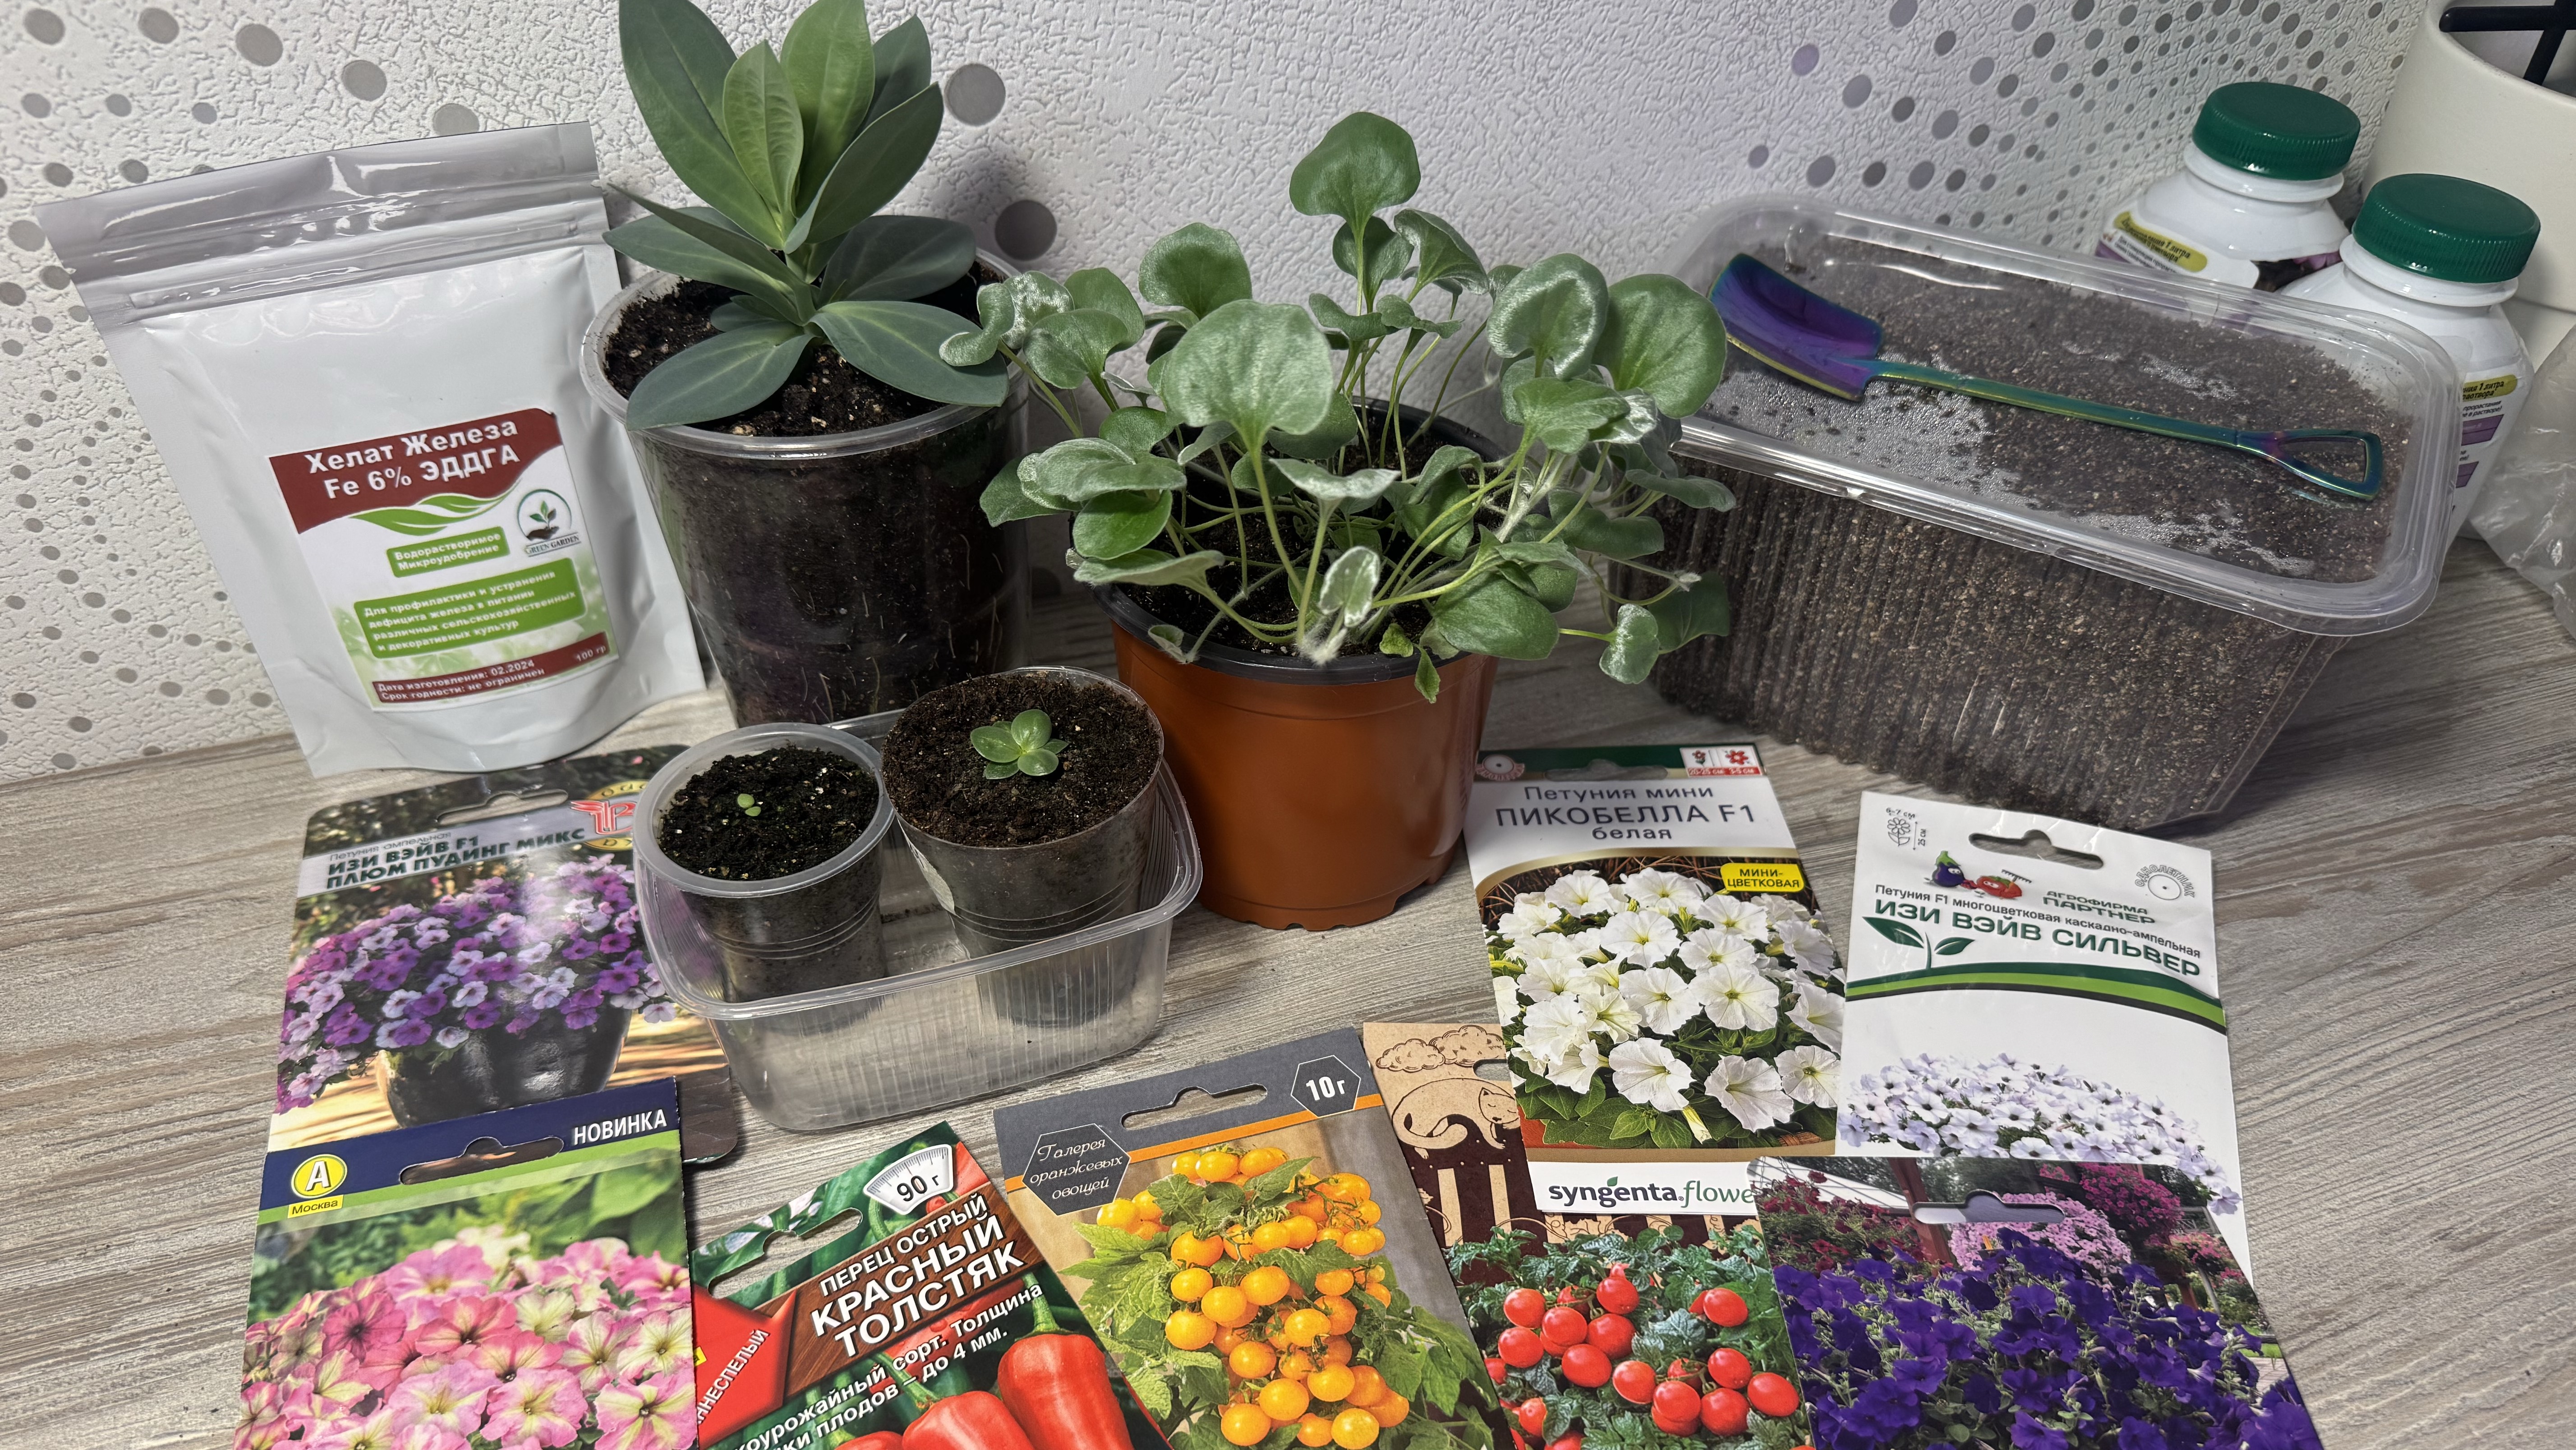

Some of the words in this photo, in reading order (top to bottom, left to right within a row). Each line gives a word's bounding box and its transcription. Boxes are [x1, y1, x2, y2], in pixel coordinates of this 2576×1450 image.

[2484, 381, 2504, 391] литра
[304, 444, 393, 474] Хелат
[401, 420, 518, 457] Железа
[324, 478, 360, 499] Fe
[368, 466, 412, 492] 6%
[421, 444, 520, 481] ЭДДГА
[395, 534, 501, 561] Водорастворимое
[397, 545, 499, 571] Микроудобрение
[525, 543, 549, 554] GREEN
[551, 535, 579, 548] GARDEN
[363, 607, 387, 618] Для
[390, 590, 477, 614] профилактики
[489, 571, 556, 595] устранения
[368, 613, 427, 629] дефицита
[430, 603, 474, 619] железа
[487, 589, 535, 607] питании
[373, 624, 439, 641] различных
[442, 590, 576, 630] сельскохозяйственных
[389, 631, 471, 652] декоративных
[474, 620, 519, 636] культур
[576, 650, 593, 662] 100
[595, 644, 607, 656] гр
[378, 682, 404, 692] Дата
[408, 672, 488, 690] изготовления:
[490, 659, 535, 676] 02.2024
[382, 690, 409, 701] Срок
[411, 686, 466, 698] годности:
[468, 682, 483, 691] не
[485, 668, 545, 688] ограничен
[1524, 786, 1636, 802] Петуния
[1646, 786, 1713, 799] мини
[1496, 806, 1710, 826] ПИКОБЕЛЛА
[1719, 805, 1755, 823] F1
[330, 846, 379, 862] Петуния
[382, 832, 451, 850] ампельная
[1592, 827, 1672, 841] белая
[1920, 829, 1926, 838] см
[327, 864, 407, 889] ПЛЮМ
[414, 842, 511, 871] ПУДИНГ
[517, 828, 585, 852] МИКС
[328, 857, 379, 875] ИЗИ
[386, 841, 450, 864] ВЭЙВ
[456, 836, 479, 850] F1
[1727, 877, 1801, 889] ЦВЕТКОВАЯ
[1739, 867, 1784, 878] МИНИ-
[2134, 864, 2195, 898] ОДНОЛЕТНИК
[2042, 897, 2156, 925] ПАРТНЕР
[2047, 890, 2148, 915] АГРОФИРМА
[1875, 884, 1931, 902] Петуния
[1935, 892, 1948, 904] F1
[1953, 899, 2061, 924] многоцветковая
[2065, 916, 2200, 958] каскадно-ампельная
[1875, 899, 1941, 924] ИЗИ
[1952, 911, 2041, 941] ВЭЙВ
[2052, 928, 2200, 977] СИЛЬВЕР
[573, 1109, 667, 1146] НОВИНКА
[1037, 1136, 1106, 1163] Галерея
[304, 1160, 332, 1192] А
[1030, 1154, 1123, 1185] оранжевых
[897, 1175, 928, 1203] 90
[931, 1174, 940, 1187] г
[1052, 1176, 1110, 1201] овощей
[291, 1196, 338, 1216] Москва
[820, 1245, 895, 1297] ПЕРЕЦ
[896, 1194, 989, 1254] ОСТРЫЙ
[812, 1214, 1004, 1338] КРАСНЫЙ
[833, 1241, 1025, 1358] ТОЛСТЯК
[892, 1335, 947, 1371] сорт.
[950, 1284, 1043, 1337] Толщина
[697, 1329, 769, 1424] ННЕСПЕЛЫЙ
[817, 1384, 898, 1438] плодов
[923, 1356, 948, 1382] до
[954, 1343, 966, 1359] 4
[971, 1327, 1007, 1352] мм.
